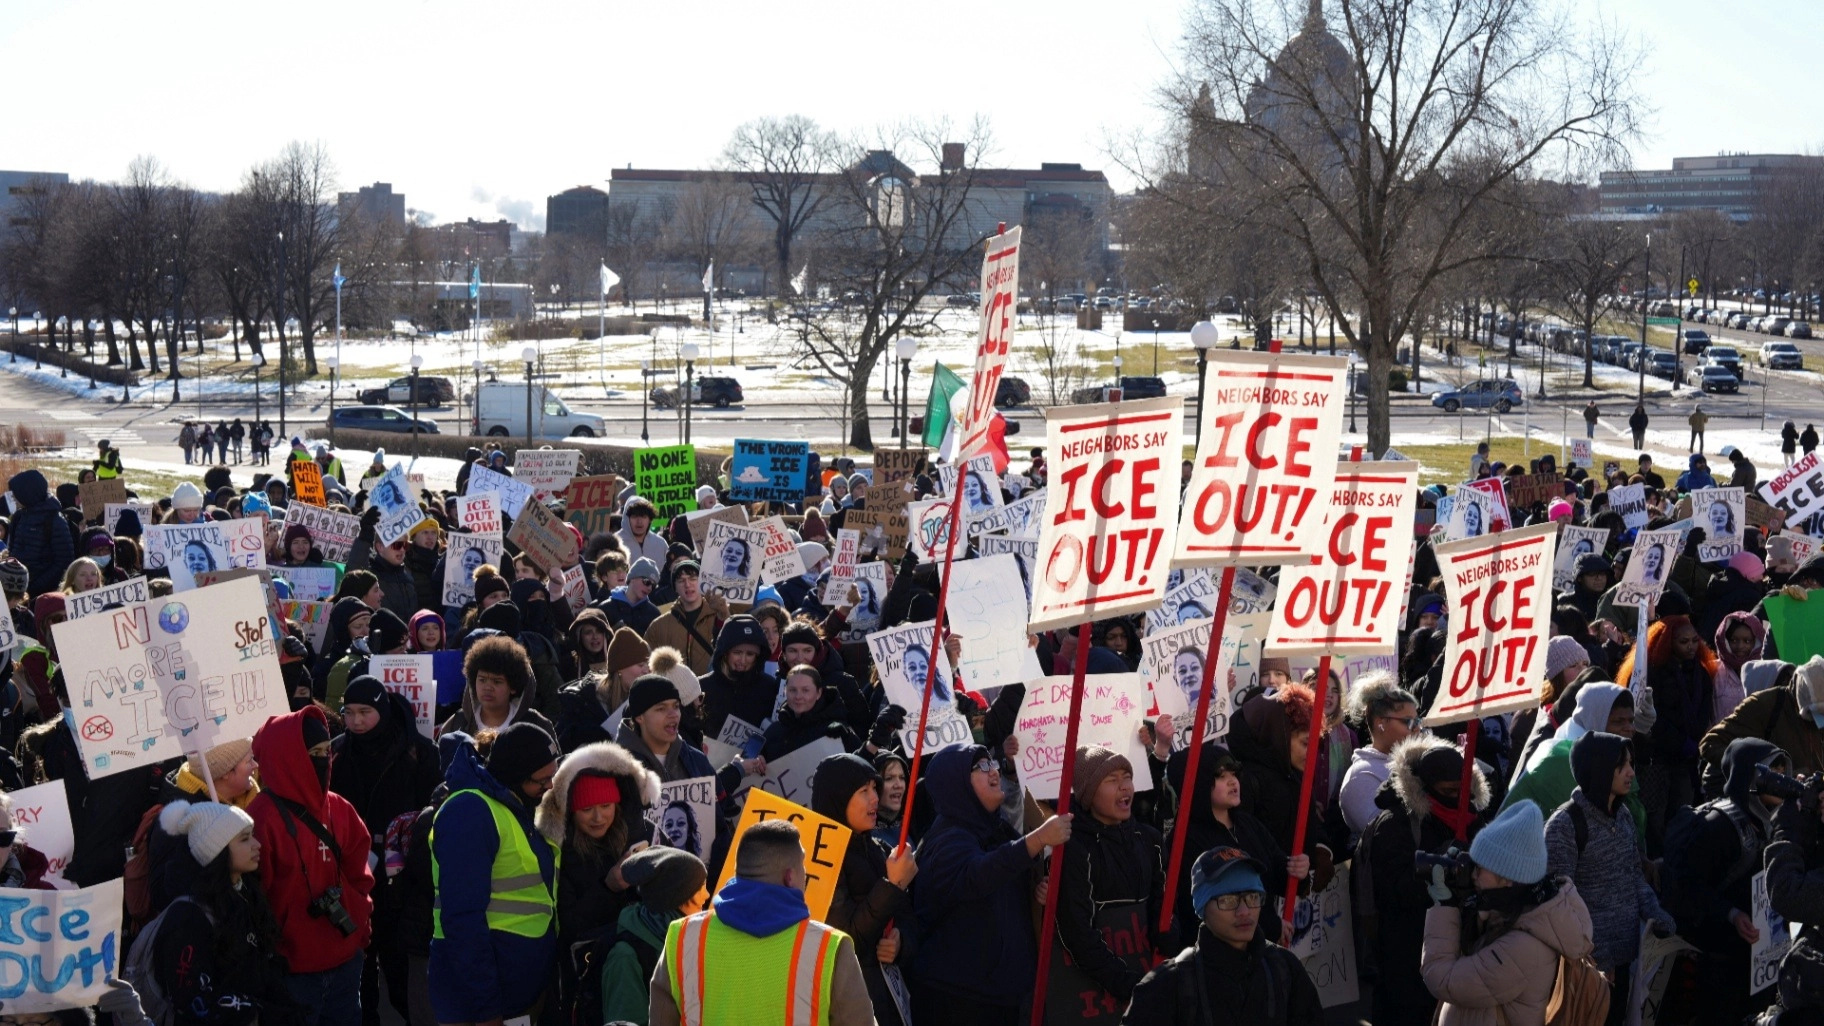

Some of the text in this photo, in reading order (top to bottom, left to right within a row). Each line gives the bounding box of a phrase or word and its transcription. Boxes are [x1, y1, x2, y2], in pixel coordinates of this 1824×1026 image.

[1217, 387, 1329, 408] NEIGHBORS SAY
[738, 442, 806, 457] THE WRONG
[1061, 431, 1168, 462] NEIGHBORS SAY
[1204, 411, 1319, 478] ICE
[293, 462, 319, 474] HATE
[640, 450, 689, 472] NO ONE
[770, 457, 800, 473] ICE
[296, 473, 319, 486] WILL
[640, 470, 695, 488] IS ILLEGAL
[773, 475, 789, 488] IS
[1769, 452, 1819, 496] ABOLISH
[304, 485, 319, 494] NOT
[567, 480, 613, 510] ICE
[657, 486, 696, 502] STOLEN
[754, 487, 804, 502] MELTING
[867, 486, 901, 501] NO ICE
[1053, 457, 1160, 526] ICE
[1330, 490, 1403, 507] HBORS SAY
[1455, 487, 1490, 513] JUSTICE
[1694, 489, 1743, 507] JUSTICE
[1775, 471, 1824, 519] ICE
[466, 500, 491, 512] ICE
[526, 500, 549, 526] They
[1193, 479, 1318, 542] OUT!
[382, 508, 422, 542] GOOD
[464, 511, 495, 523] OUT
[847, 511, 908, 528] BULLS ON
[164, 526, 223, 549] JUSTICE
[451, 535, 501, 556] JUSTICE
[709, 522, 767, 548] JUSTICE
[841, 539, 855, 551] ICE
[1310, 512, 1393, 572] CE
[1563, 528, 1608, 545] JUSTICE
[1634, 532, 1680, 550] JUSTICE
[169, 545, 182, 561] for
[765, 540, 795, 557] OW!
[838, 552, 855, 563] OUT
[1700, 543, 1742, 559] GOOD
[1046, 528, 1165, 594] OUT!
[1456, 552, 1542, 588] NEIGHBORS SAY
[565, 567, 583, 583] ARE
[855, 564, 884, 581] TICE
[70, 581, 146, 620] JUSTICE
[1150, 577, 1214, 627] JUSTICE
[1284, 576, 1392, 633] OUT!
[1456, 575, 1535, 645] ICE
[83, 641, 186, 707] MORE
[383, 667, 418, 684] ICE
[885, 655, 903, 679] for
[1155, 659, 1173, 683] for
[1449, 635, 1538, 698] OUT!
[1027, 684, 1113, 708] I DRK MY
[1019, 714, 1056, 732] HORCHATA
